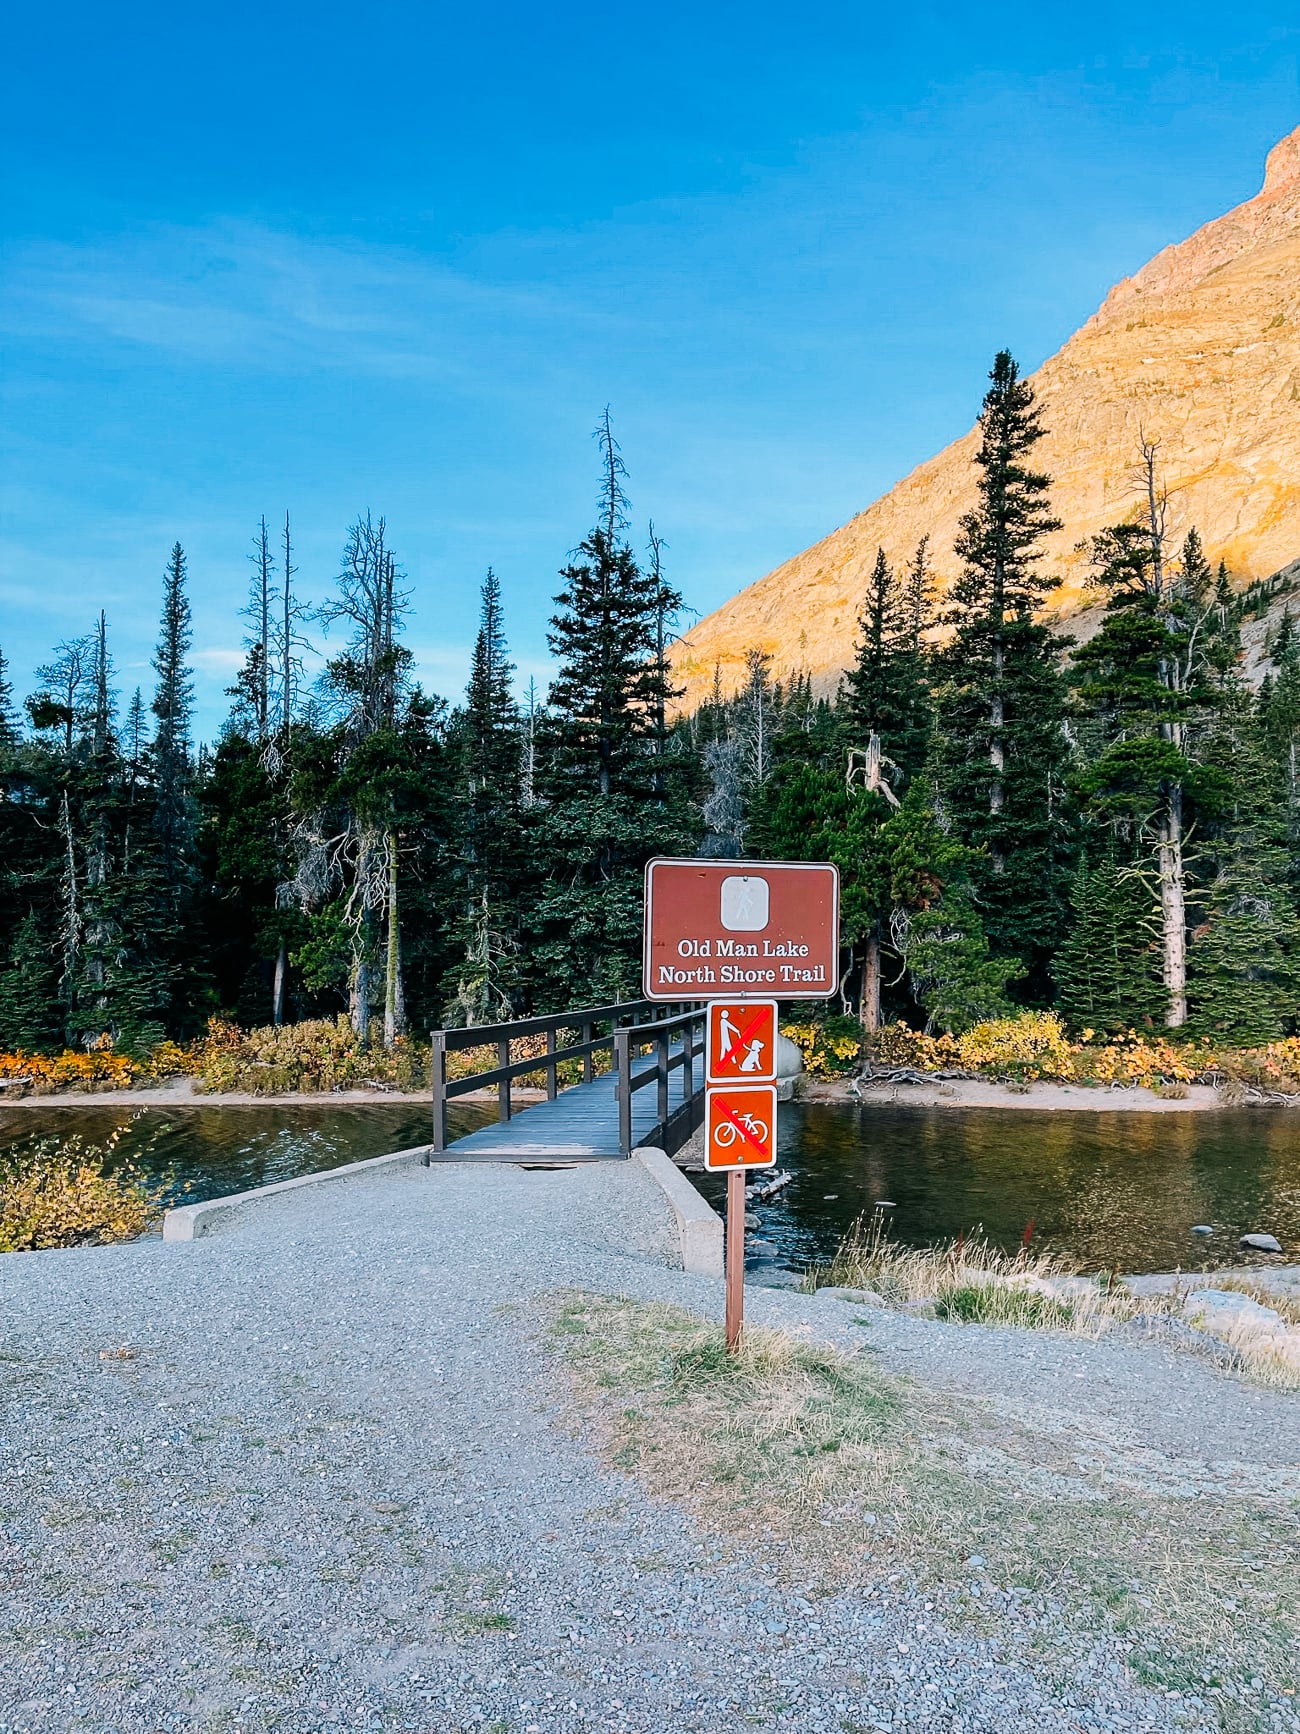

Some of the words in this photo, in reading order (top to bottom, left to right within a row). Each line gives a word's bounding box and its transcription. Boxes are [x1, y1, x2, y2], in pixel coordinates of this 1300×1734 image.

[677, 939, 712, 958] Old
[715, 940, 758, 957] Man
[762, 940, 809, 957] Lake
[658, 965, 717, 984] North
[720, 965, 776, 983] Shore
[779, 964, 826, 982] Trail
